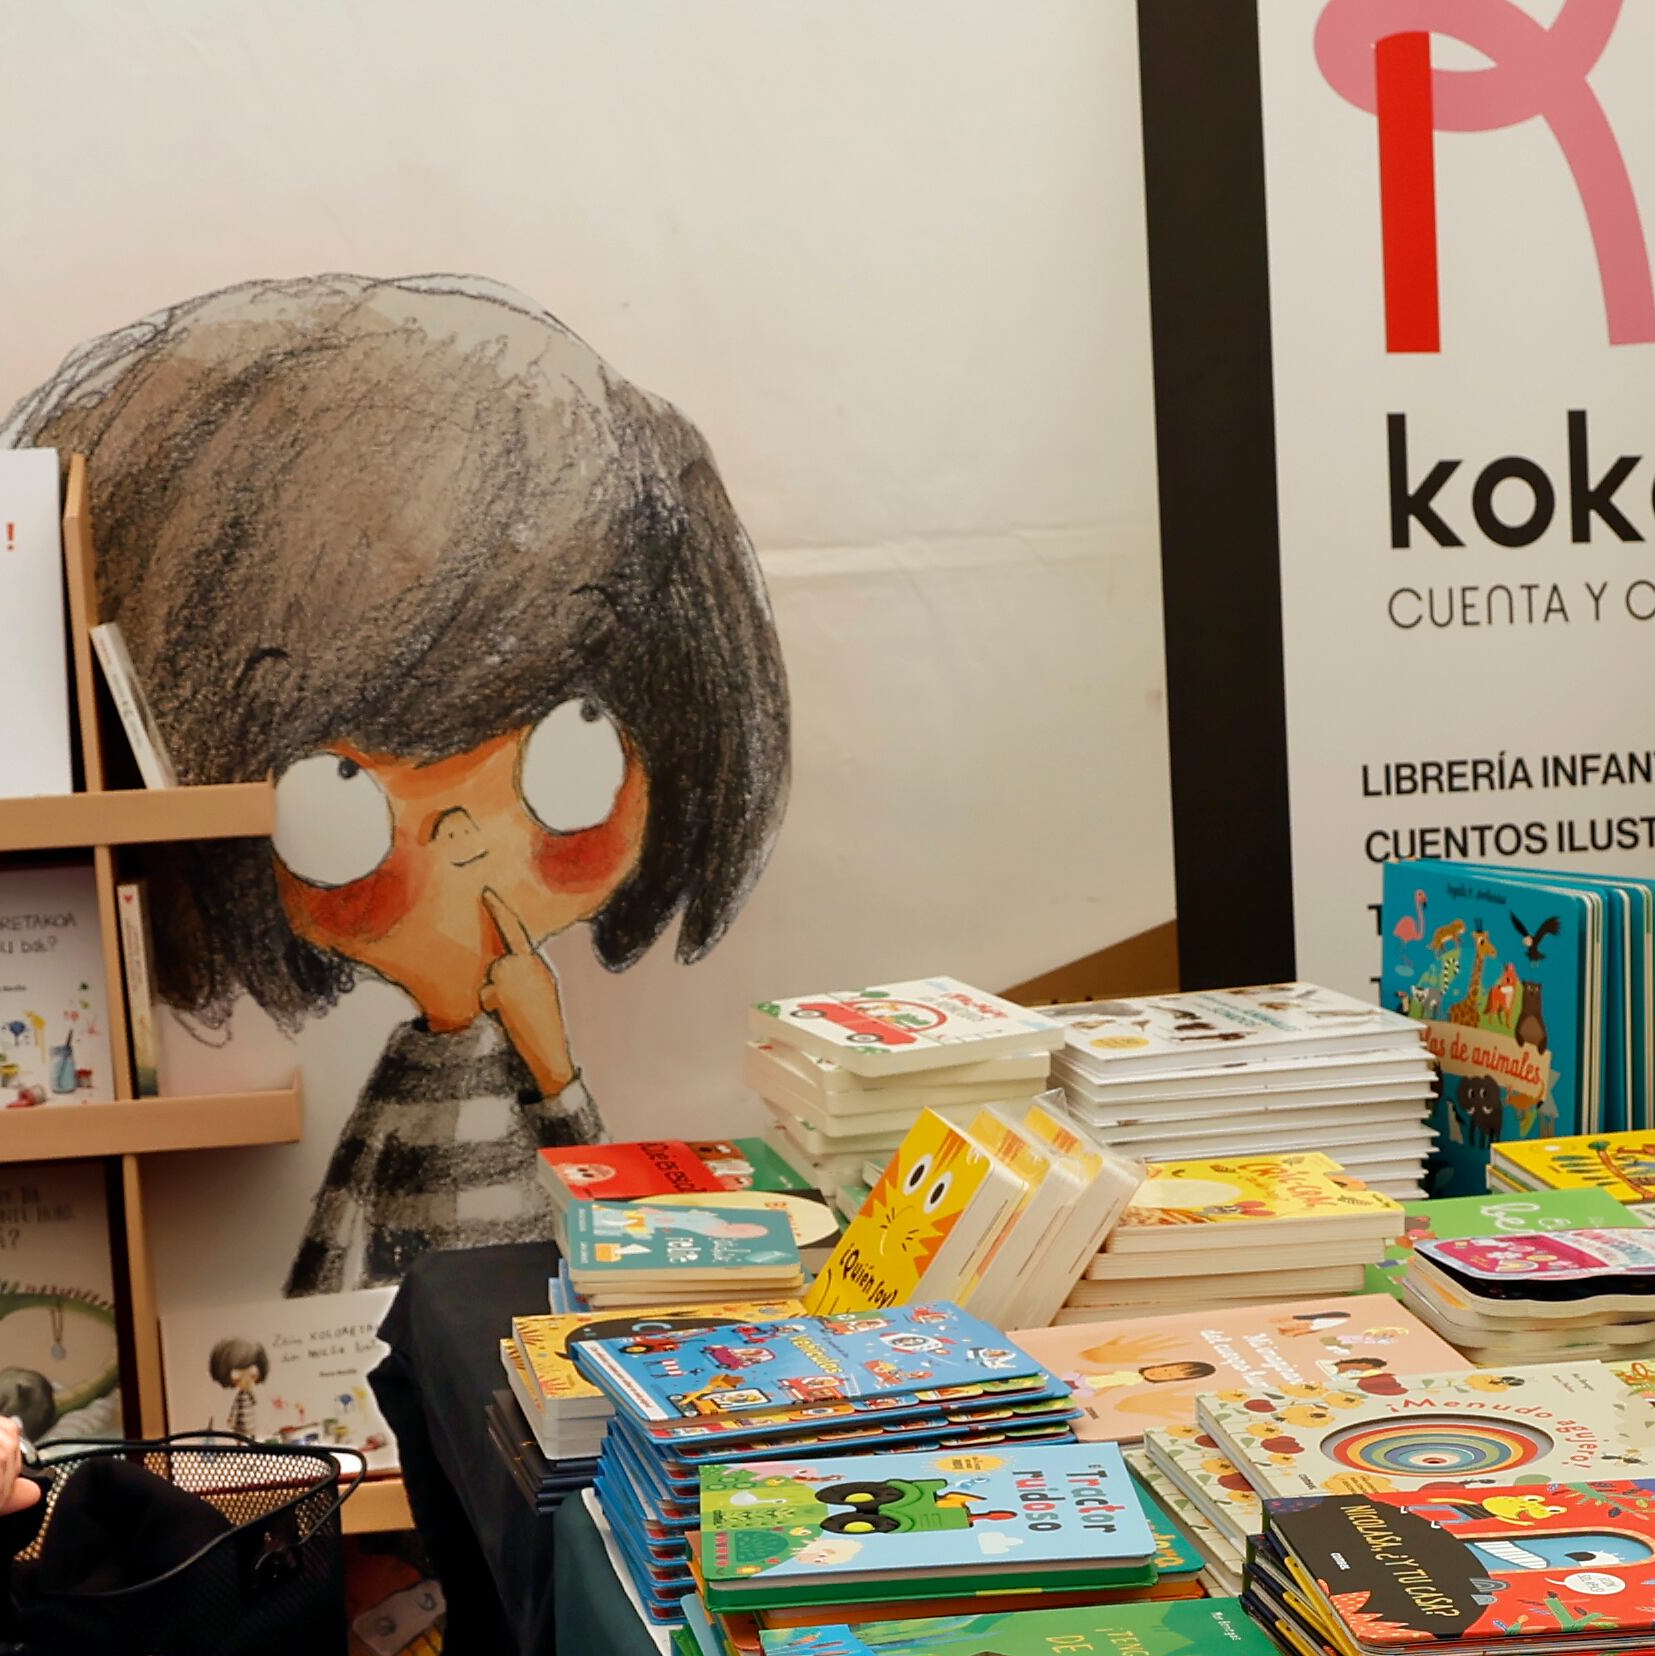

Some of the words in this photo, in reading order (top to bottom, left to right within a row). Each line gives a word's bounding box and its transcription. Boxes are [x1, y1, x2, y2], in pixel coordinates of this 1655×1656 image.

[1388, 583, 1570, 629] CUENTA
[1584, 581, 1609, 622] Y
[1361, 750, 1533, 797] LIBRERÍA
[1364, 821, 1548, 864] CUENTOS
[1450, 1033, 1469, 1063] de
[1472, 1043, 1544, 1092] animales
[1012, 1471, 1066, 1533] ruidoso
[1066, 1469, 1126, 1534] Tractor
[1393, 1569, 1425, 1586] TU
[1404, 1583, 1462, 1618] CASA?
[1046, 1633, 1094, 1655] DE
